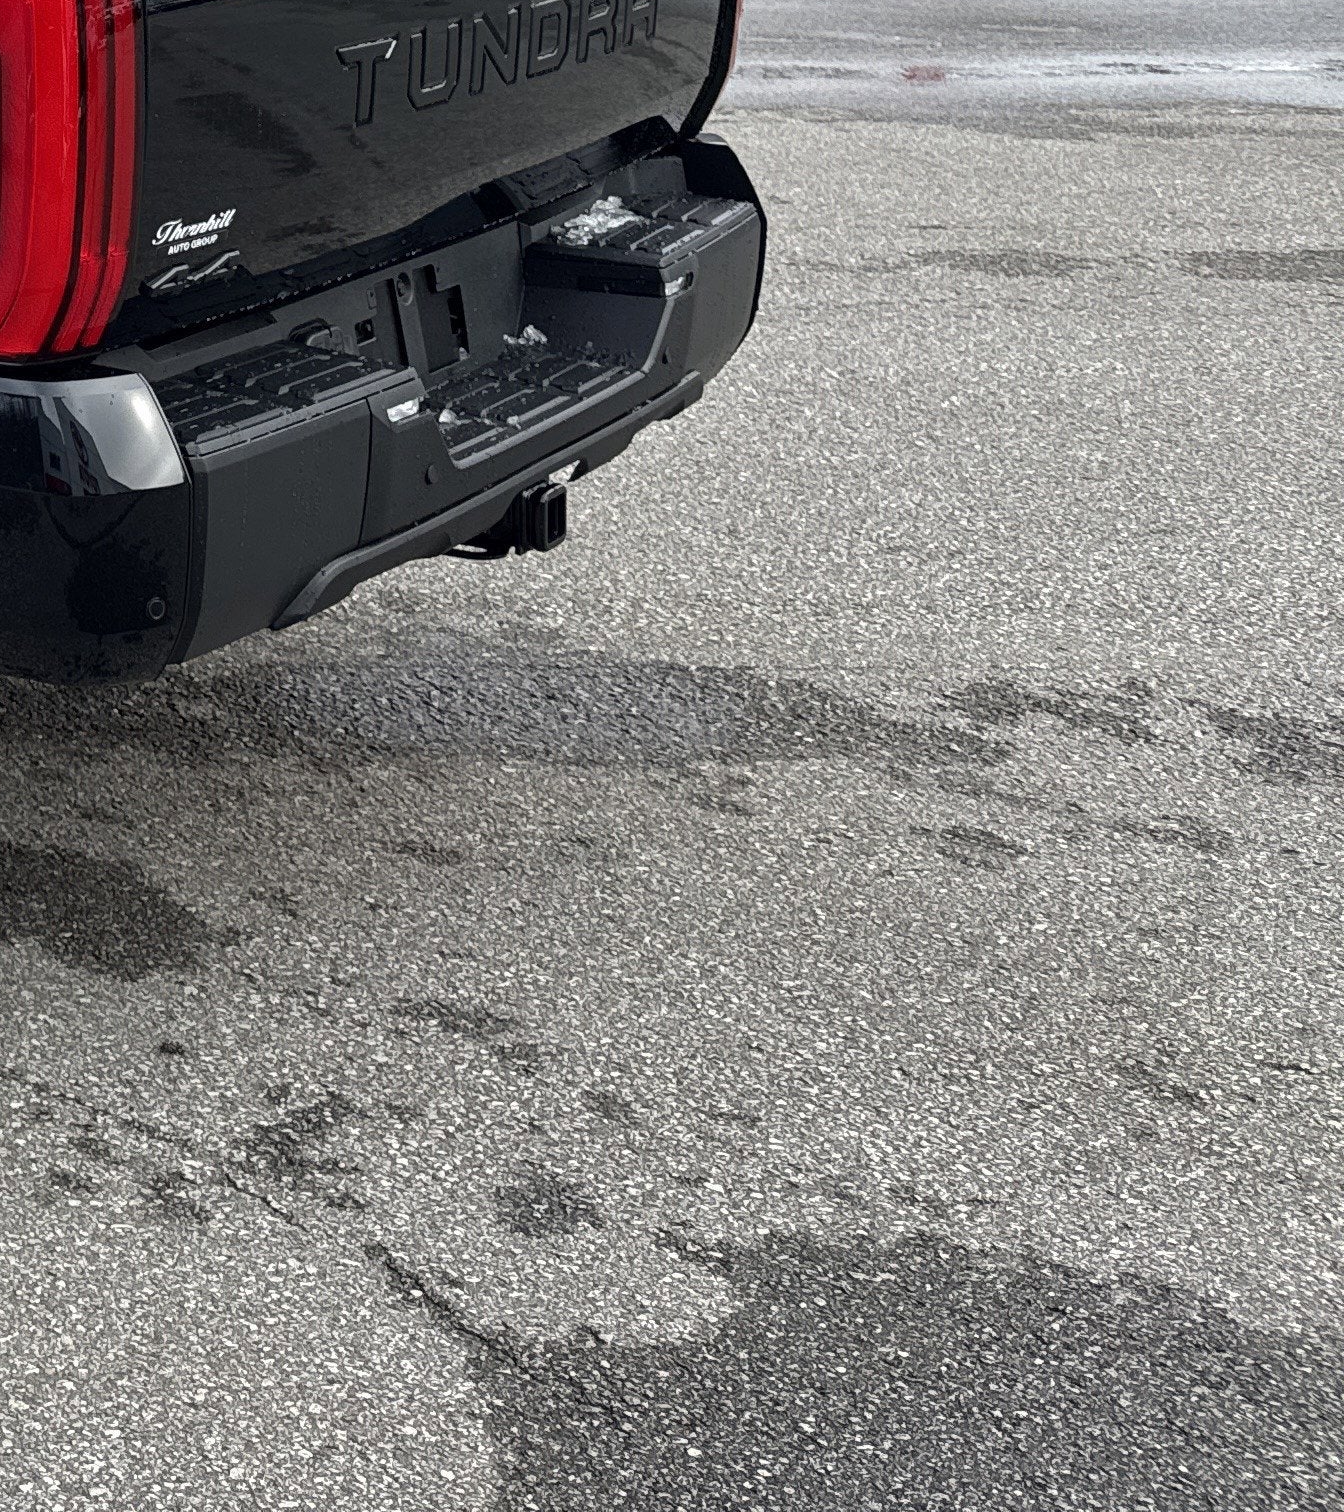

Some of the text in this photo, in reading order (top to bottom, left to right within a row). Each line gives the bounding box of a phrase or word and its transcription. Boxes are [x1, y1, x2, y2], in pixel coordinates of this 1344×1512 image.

[152, 208, 236, 246] Thornhill
[168, 234, 218, 255] AUTO GROUP
